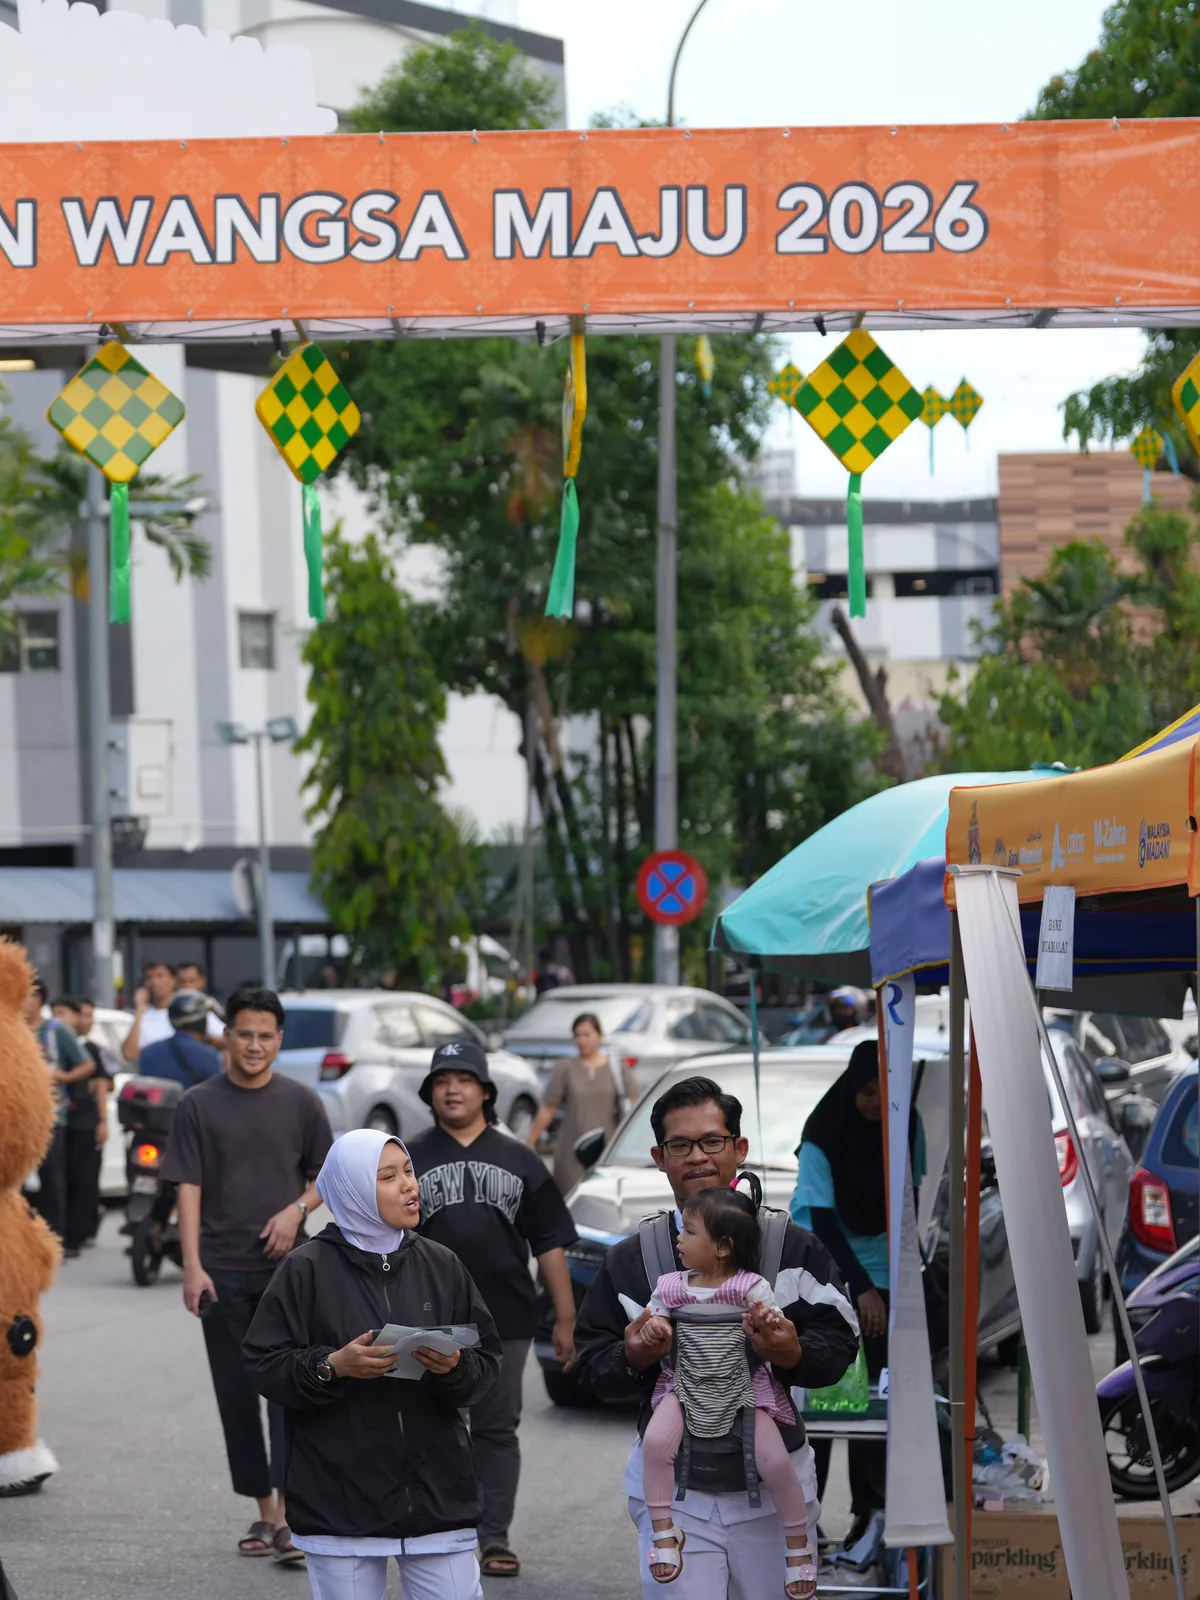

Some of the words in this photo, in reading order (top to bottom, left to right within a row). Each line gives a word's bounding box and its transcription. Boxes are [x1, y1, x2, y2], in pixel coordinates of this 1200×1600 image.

[62, 189, 468, 267] WANGSA
[491, 184, 746, 258] MAJU
[775, 180, 987, 255] 2026
[1147, 822, 1171, 839] MALAYSIA
[1146, 840, 1171, 860] MADANI
[1048, 919, 1062, 931] BANK
[418, 1161, 466, 1221] NEW
[971, 1548, 1057, 1574] parkling
